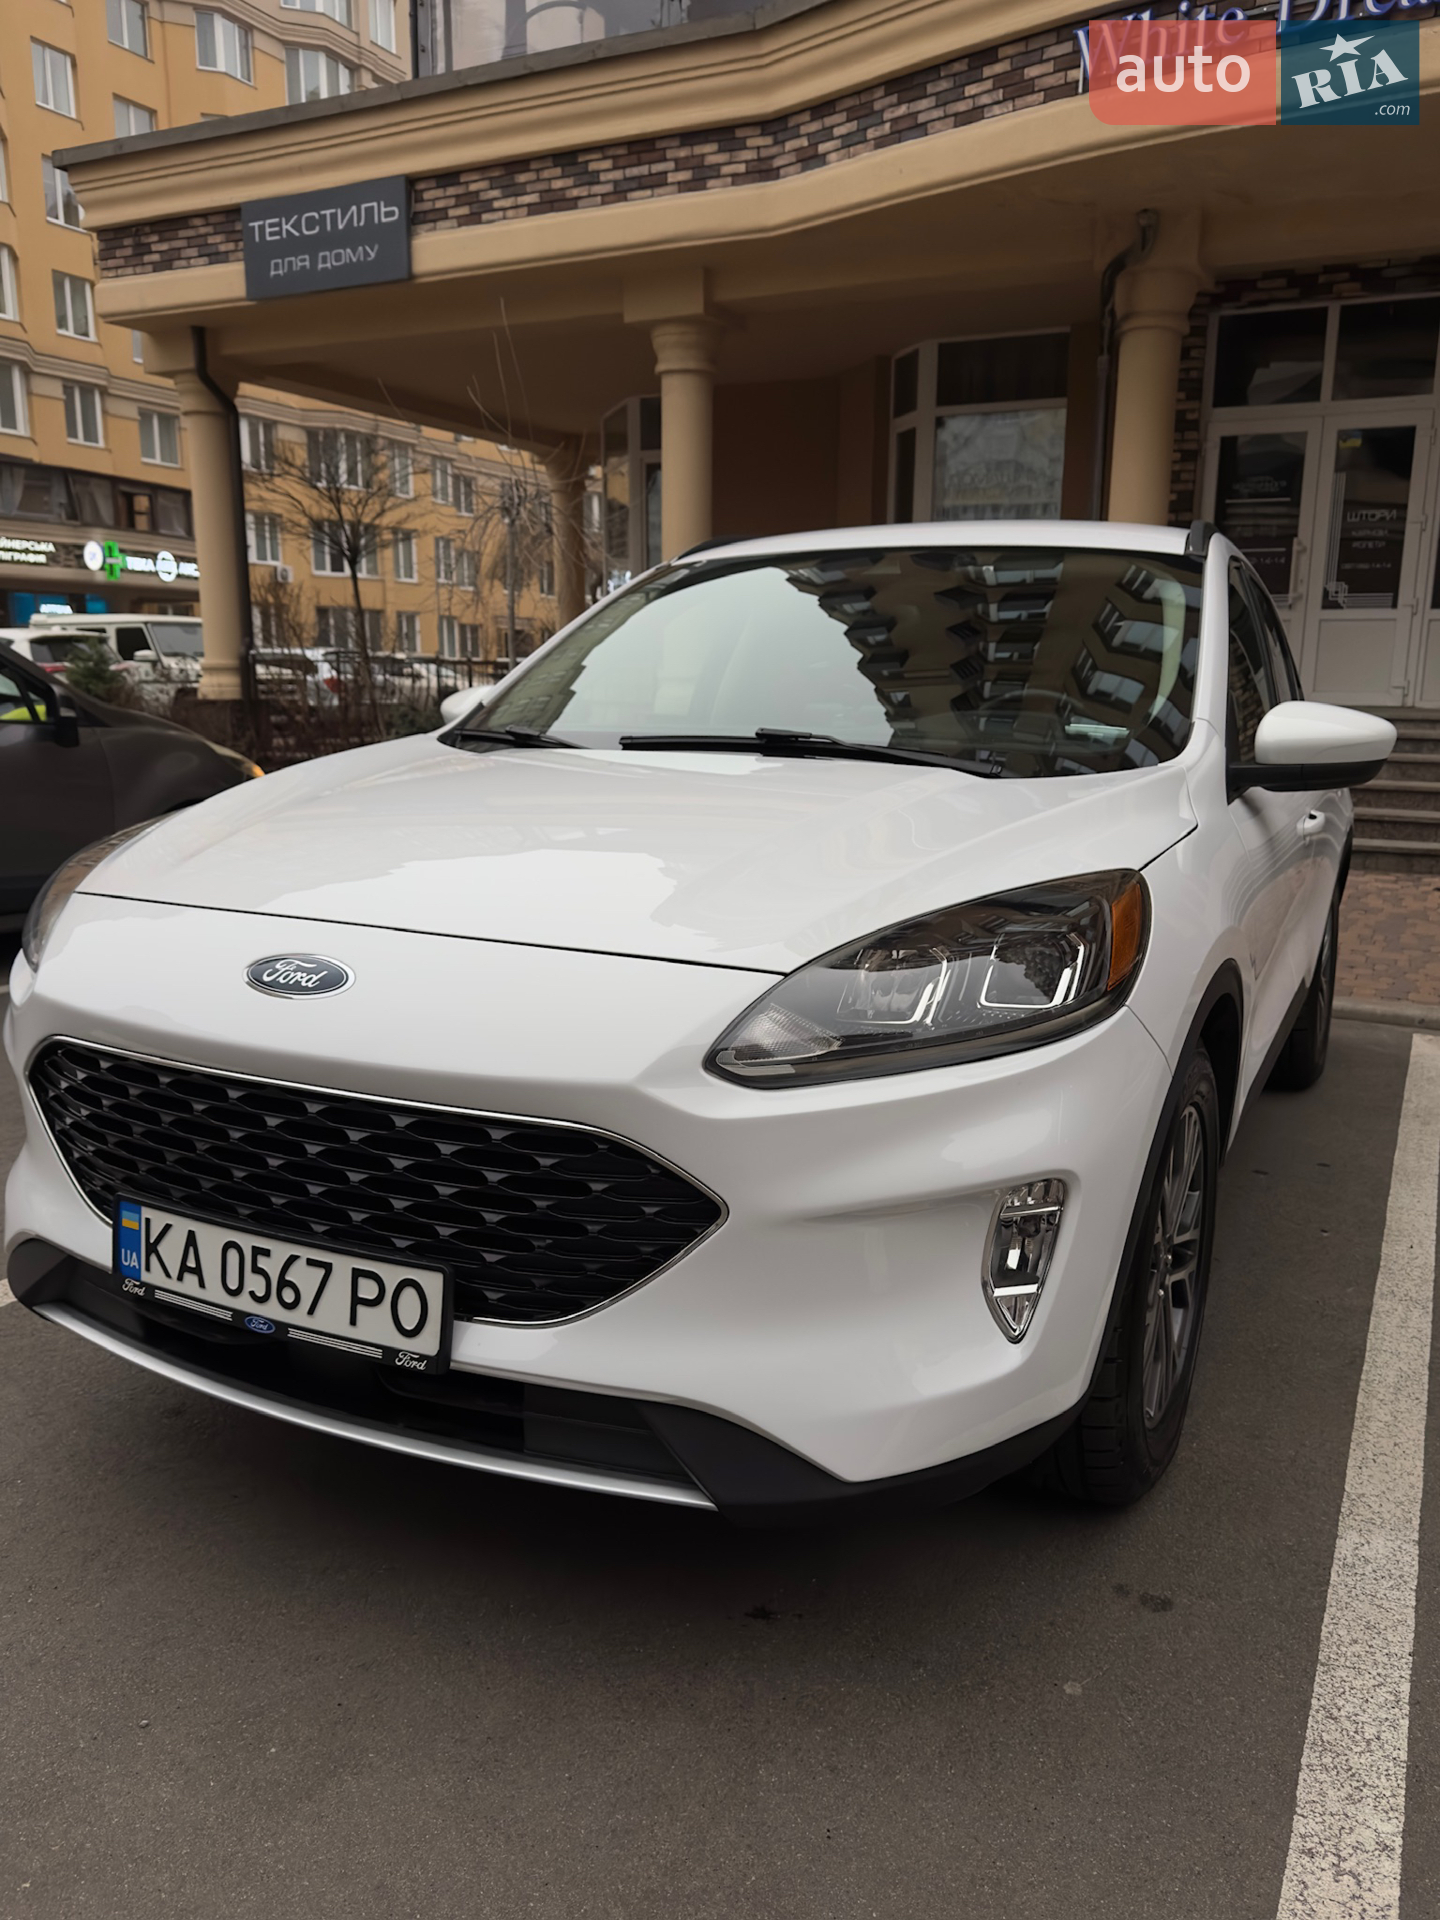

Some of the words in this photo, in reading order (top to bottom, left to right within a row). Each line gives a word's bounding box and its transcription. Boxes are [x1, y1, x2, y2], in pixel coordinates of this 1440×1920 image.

[1073, 0, 1248, 79] White
[249, 201, 399, 242] ТЕКСТИЛЬ
[270, 255, 310, 278] ДЛЯ
[317, 244, 379, 271] ДОМУ
[263, 959, 328, 988] Ford
[122, 1249, 139, 1269] UA
[122, 1278, 146, 1297] Ford
[144, 1217, 206, 1289] KA
[220, 1240, 333, 1316] 0567
[349, 1267, 429, 1338] PO
[250, 1316, 270, 1332] Ford
[394, 1351, 427, 1371] Ford
